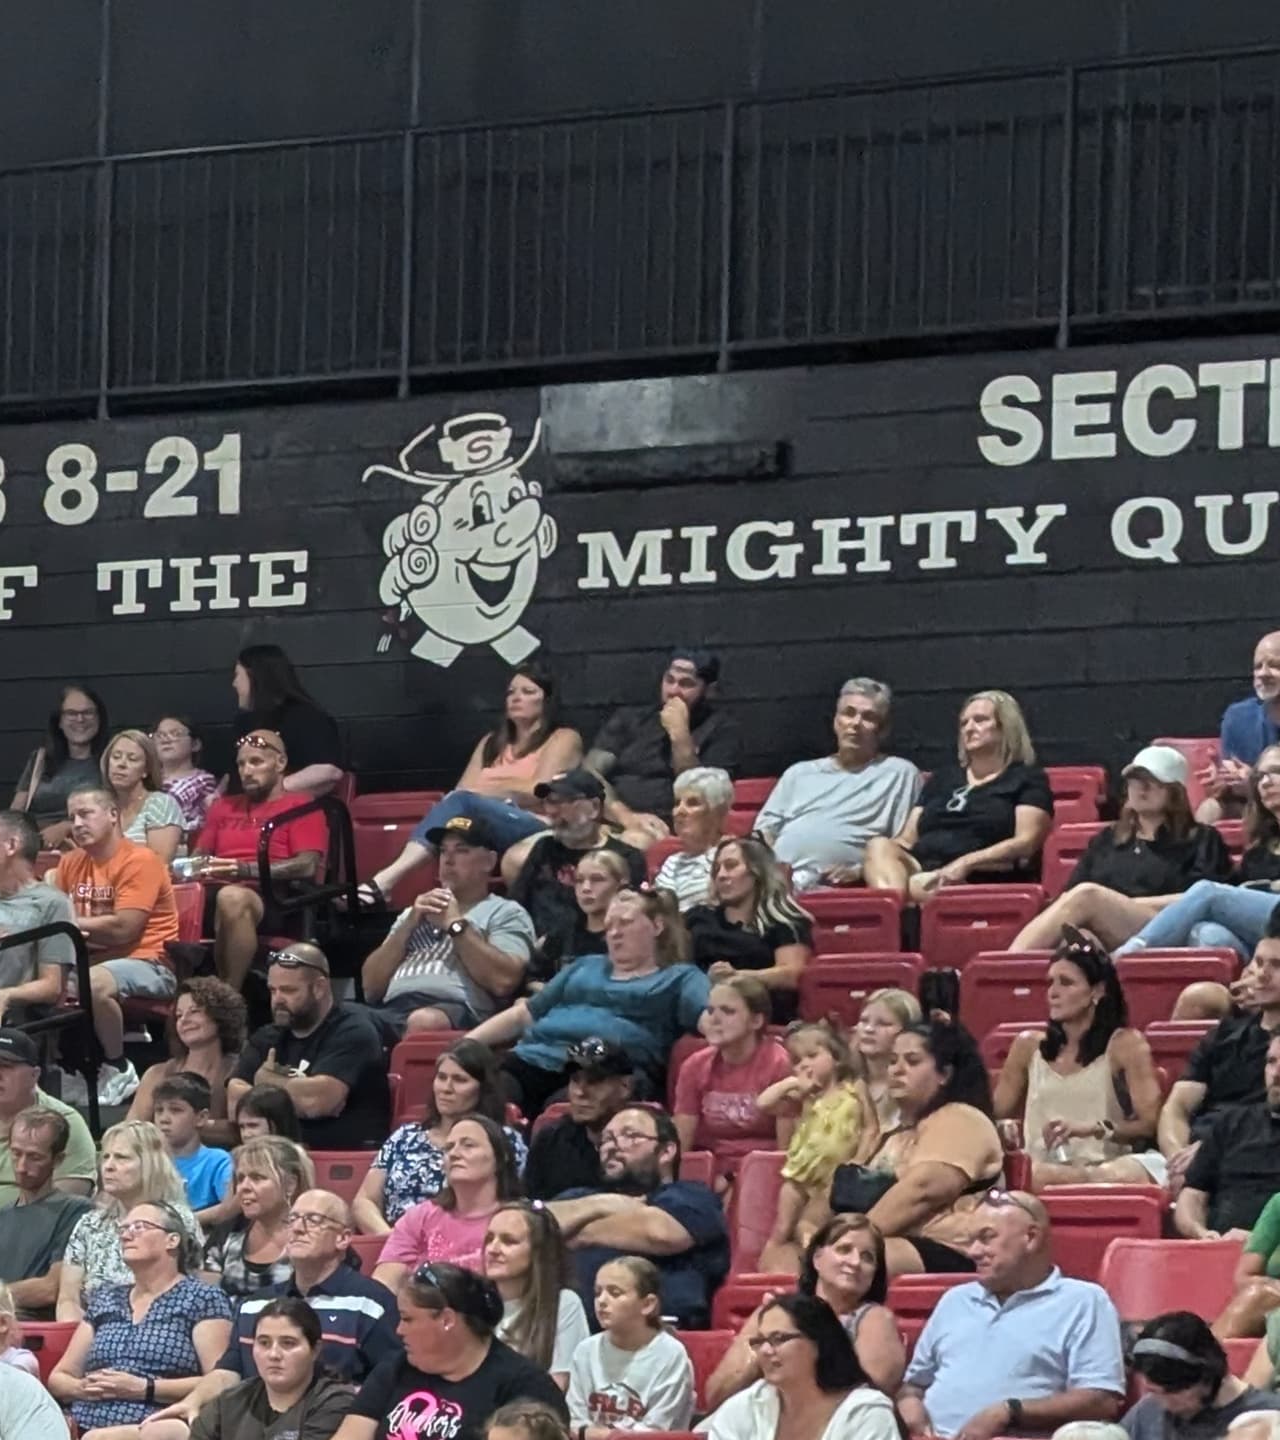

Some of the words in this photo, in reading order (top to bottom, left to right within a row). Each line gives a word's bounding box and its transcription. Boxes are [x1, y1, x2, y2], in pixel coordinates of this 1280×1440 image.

[42, 433, 243, 526] 8-21
[96, 550, 309, 616] THE
[576, 503, 1067, 592] MIGHTY
[386, 1400, 462, 1438] Quakers
